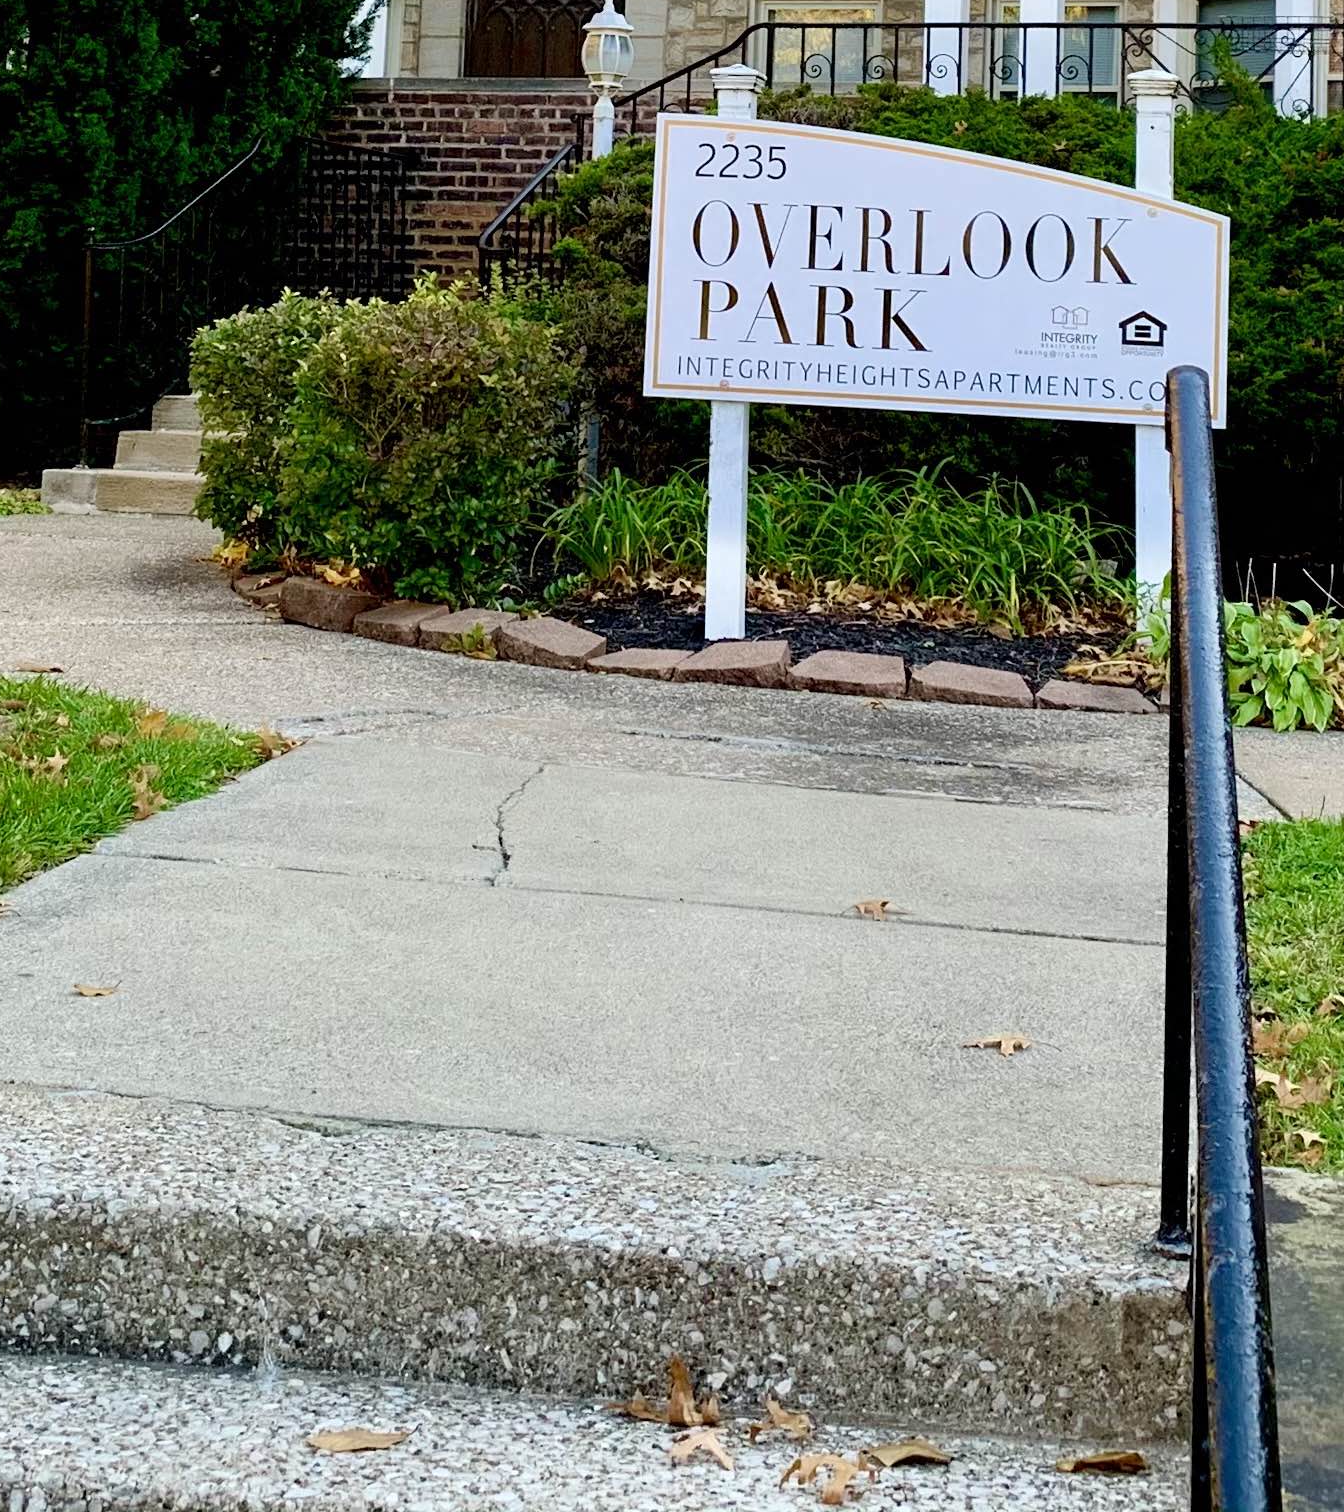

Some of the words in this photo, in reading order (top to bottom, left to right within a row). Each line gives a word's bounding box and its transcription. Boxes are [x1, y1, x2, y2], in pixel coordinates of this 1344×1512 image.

[695, 143, 787, 180] 2235
[692, 199, 1137, 286] OVERLOOK
[691, 279, 933, 353] PARK
[1041, 331, 1098, 345] INTEGRITY
[677, 355, 1167, 402] INTEGRITYHEIGHTSAPARTMENTS.CO
